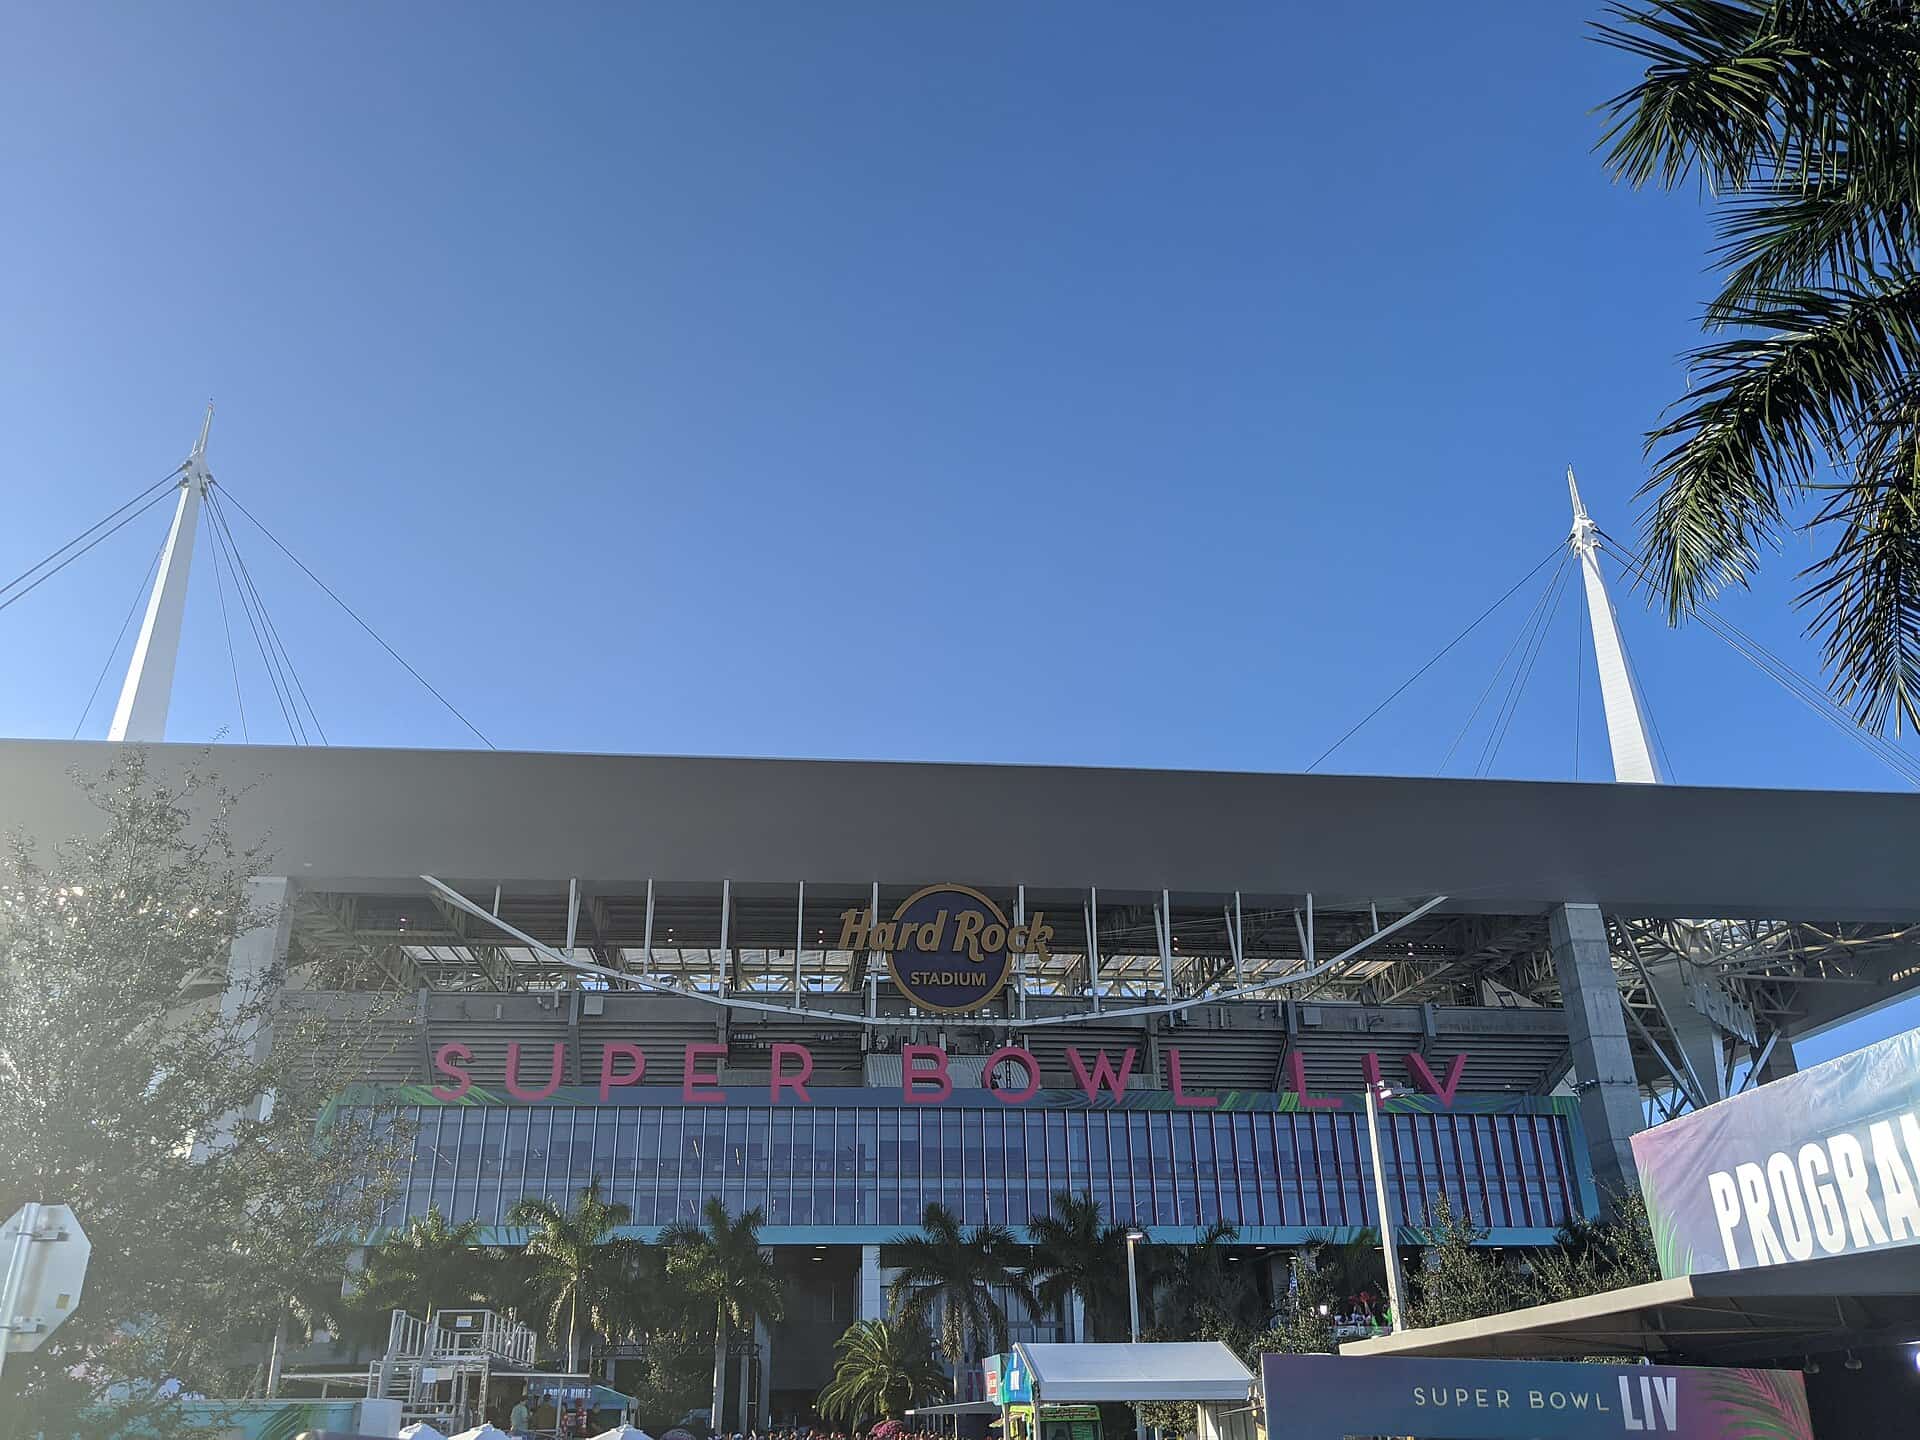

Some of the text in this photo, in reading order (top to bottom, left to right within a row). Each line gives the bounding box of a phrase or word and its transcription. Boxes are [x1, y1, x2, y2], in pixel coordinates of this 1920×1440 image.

[837, 907, 1055, 963] Hard Rock
[910, 970, 987, 986] STADIUM
[431, 1043, 1468, 1109] SUPER BOWL LIV
[1413, 1375, 1678, 1431] SUPER BOWL LIV
